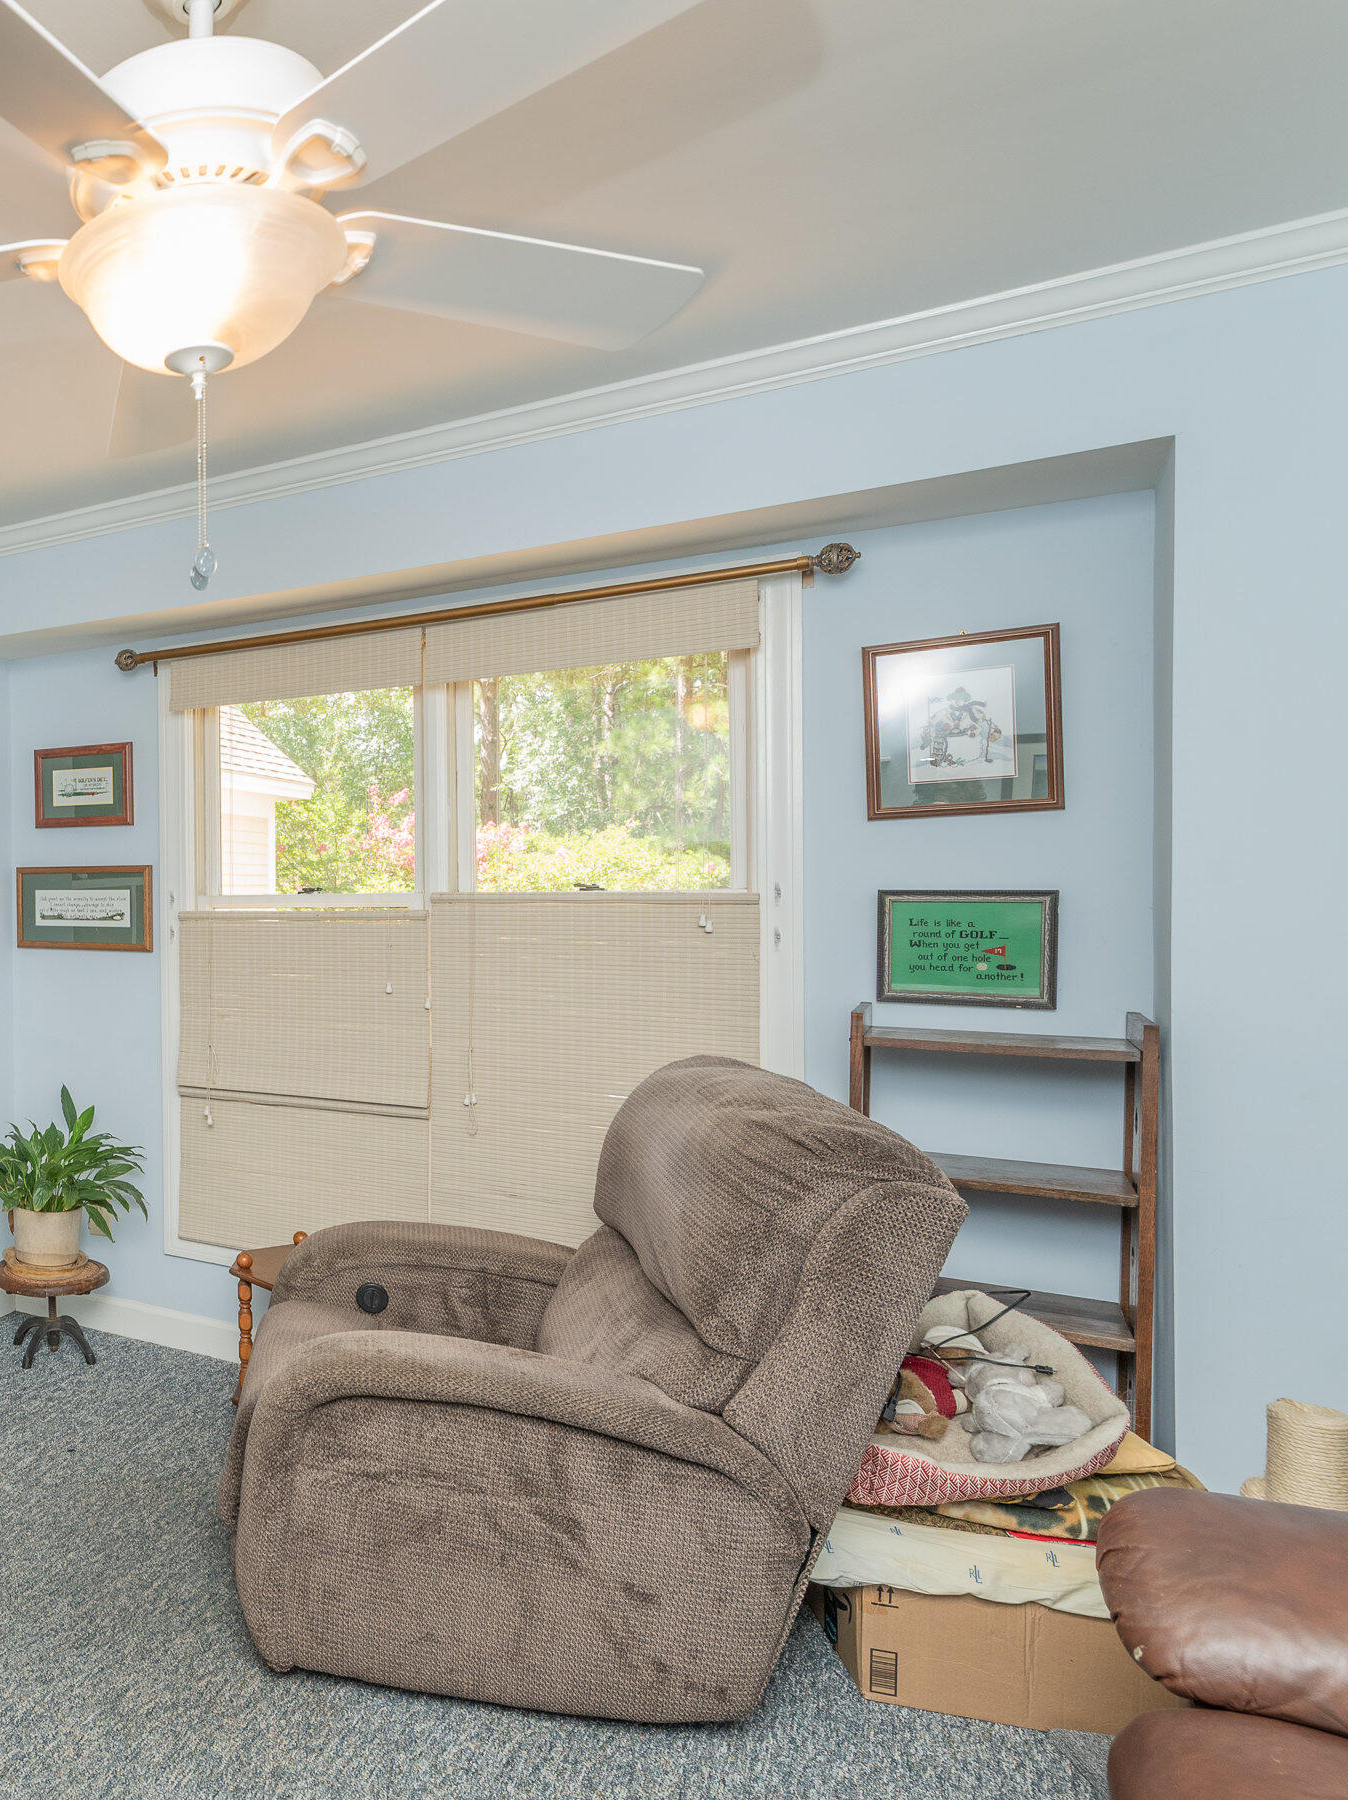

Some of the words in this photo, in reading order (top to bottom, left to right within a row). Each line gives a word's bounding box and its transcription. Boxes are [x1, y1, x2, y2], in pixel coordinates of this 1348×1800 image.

[908, 918, 929, 927] Life
[934, 919, 941, 927] is
[946, 919, 962, 928] like
[912, 930, 942, 938] round
[945, 930, 957, 939] of
[909, 939, 939, 948] When
[942, 942, 961, 951] you
[964, 940, 980, 952] get
[917, 952, 934, 961] out
[937, 952, 949, 961] of
[951, 954, 970, 962] one
[971, 953, 992, 963] hole
[908, 963, 926, 974] you
[929, 962, 955, 972] head
[959, 963, 974, 972] for
